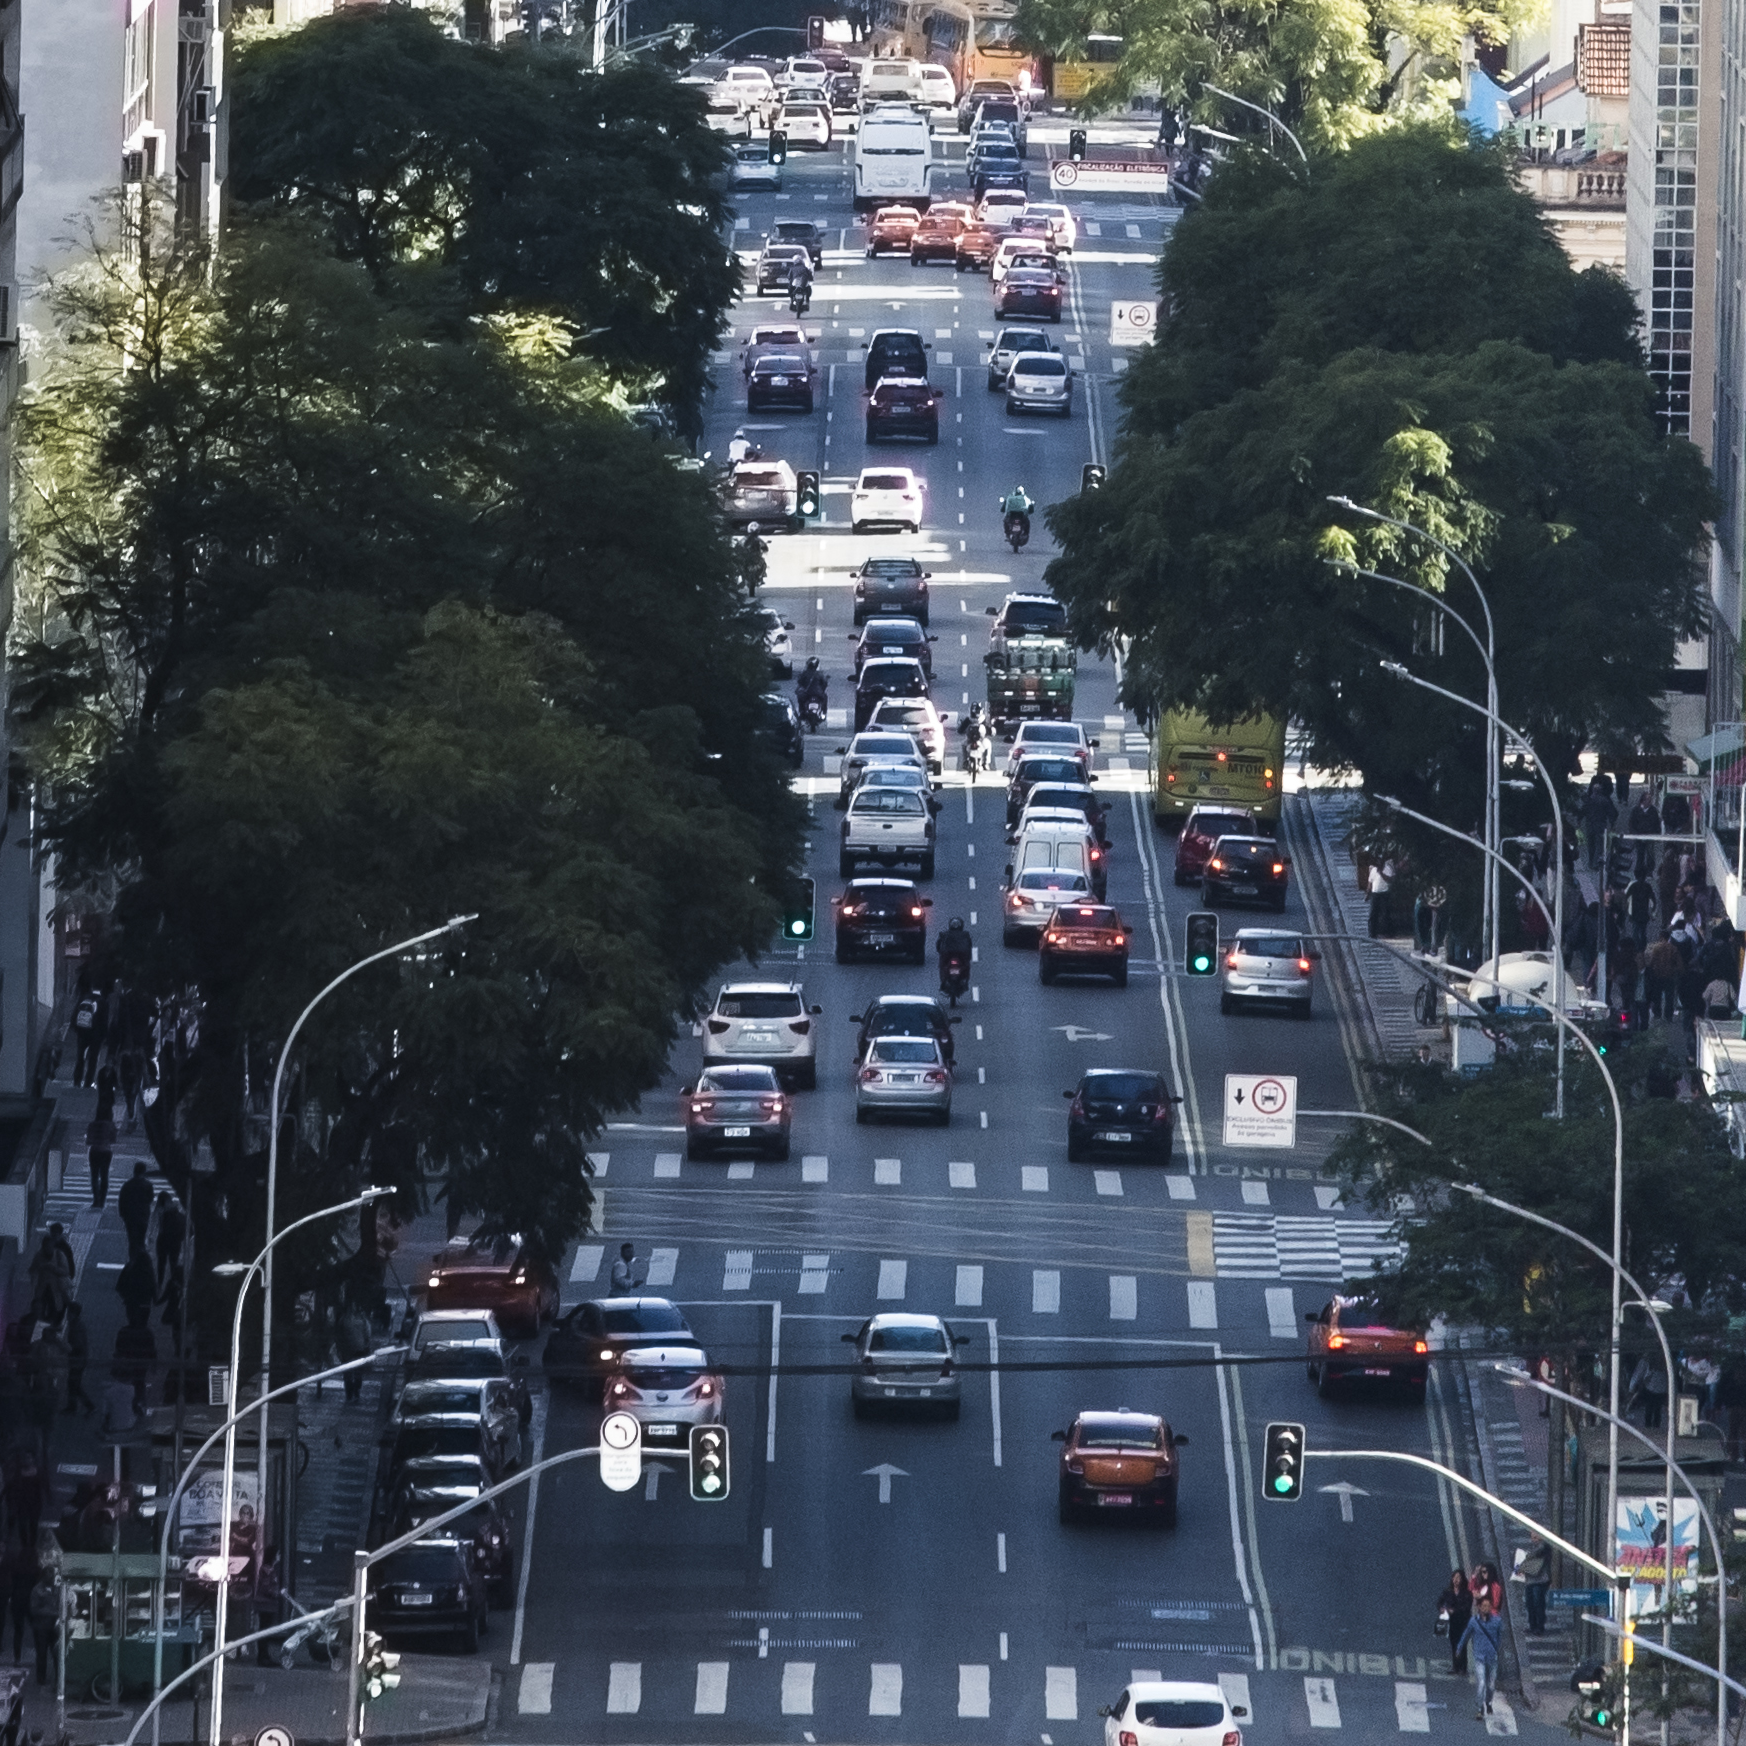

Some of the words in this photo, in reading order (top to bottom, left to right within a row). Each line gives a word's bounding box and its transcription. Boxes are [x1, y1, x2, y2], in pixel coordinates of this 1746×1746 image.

[1076, 162, 1124, 173] FISCALIZAÇÃO
[1126, 163, 1166, 173] ELETRÔNICA
[1058, 169, 1073, 179] 40
